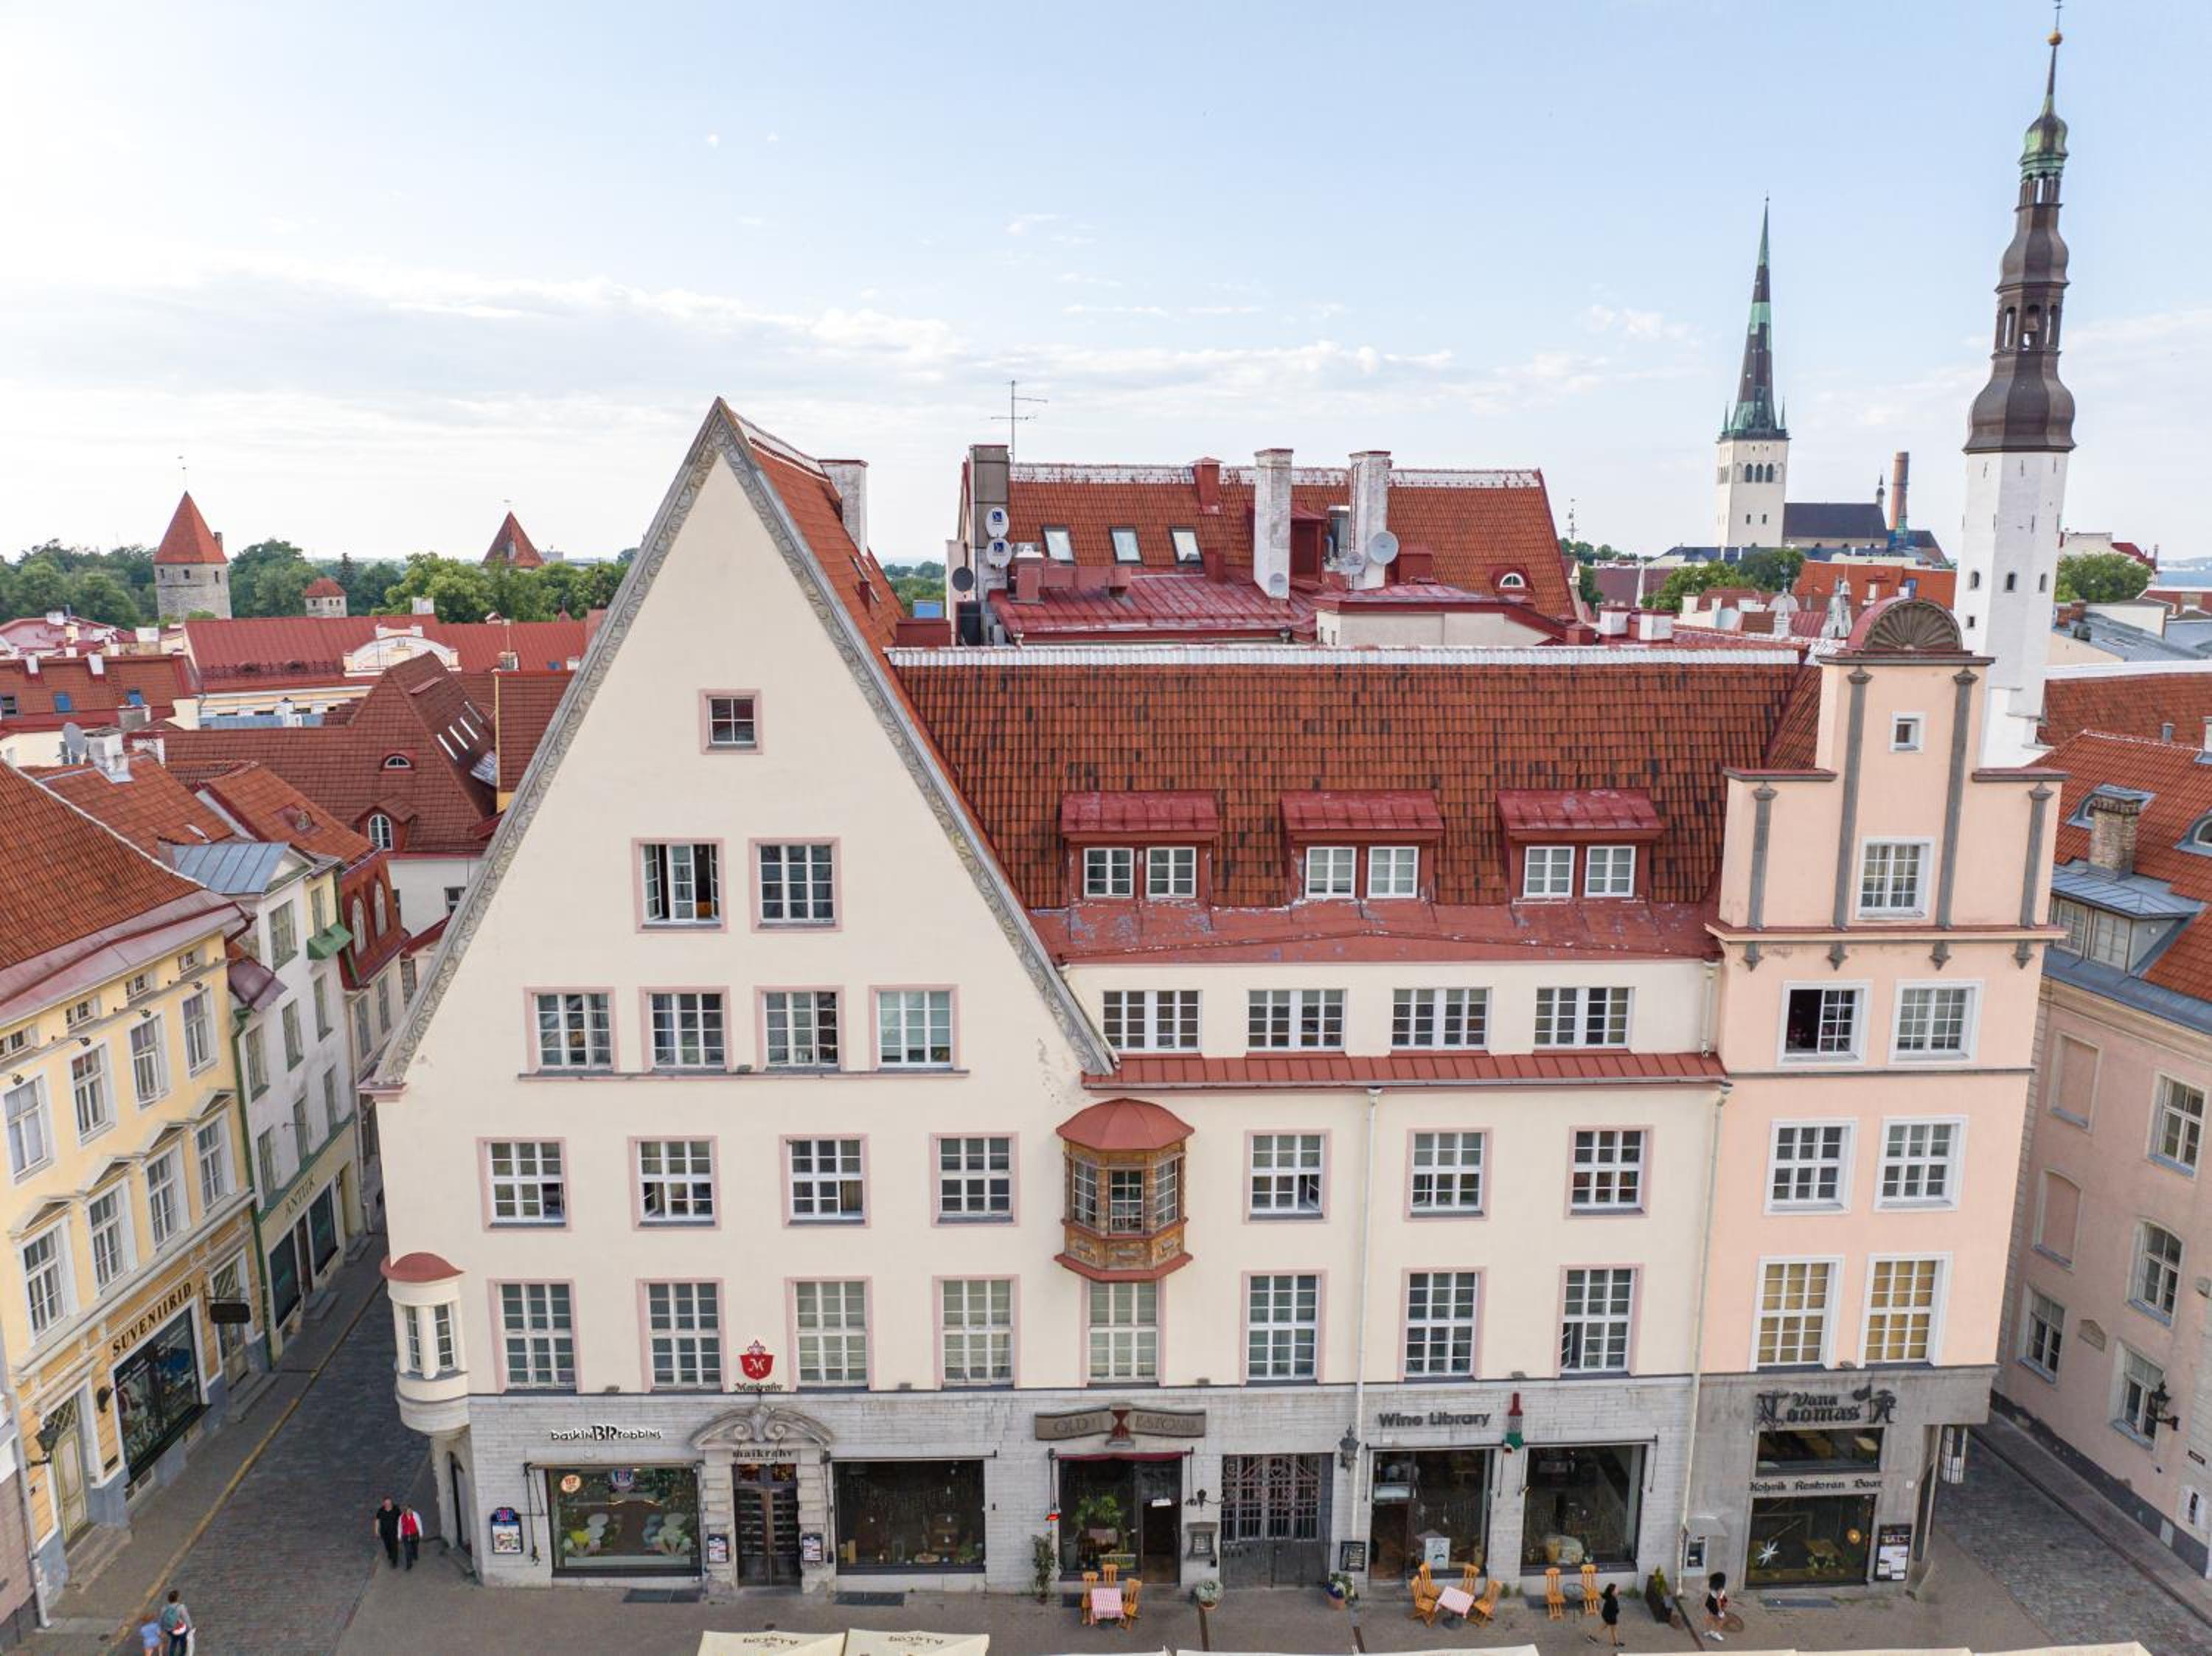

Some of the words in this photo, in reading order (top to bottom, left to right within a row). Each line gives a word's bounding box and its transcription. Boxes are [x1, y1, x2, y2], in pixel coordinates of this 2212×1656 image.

[112, 1281, 191, 1357] SUVENIIRID
[1792, 1391, 1838, 1408] Vana
[1378, 1413, 1424, 1427] Wine
[1429, 1411, 1491, 1427] Library
